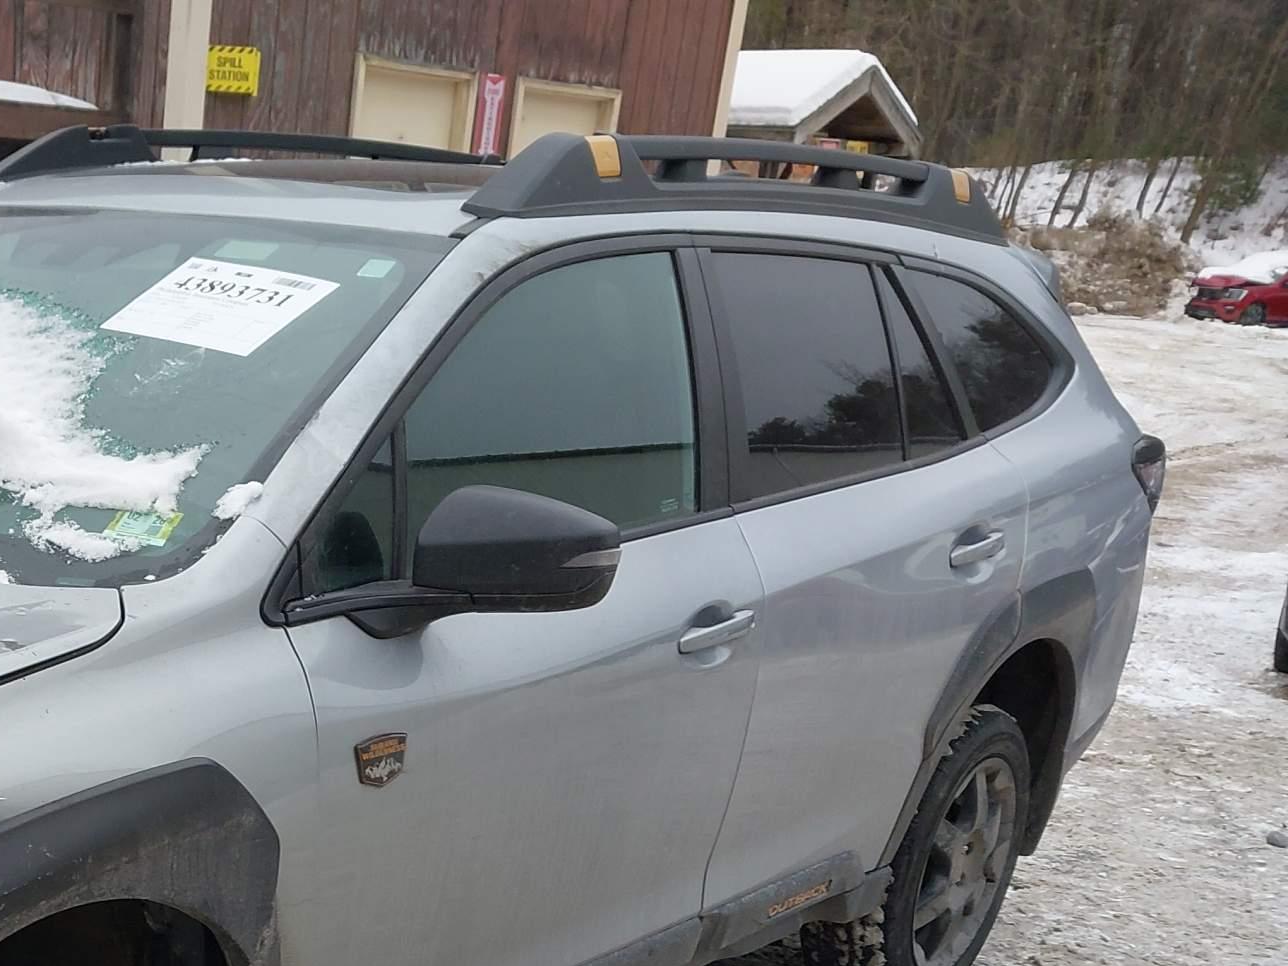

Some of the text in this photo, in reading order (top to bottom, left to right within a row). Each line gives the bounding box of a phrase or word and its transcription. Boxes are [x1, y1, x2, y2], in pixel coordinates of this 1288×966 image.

[216, 56, 242, 68] SPILL
[208, 69, 249, 82] STATION
[174, 275, 294, 308] 43893731
